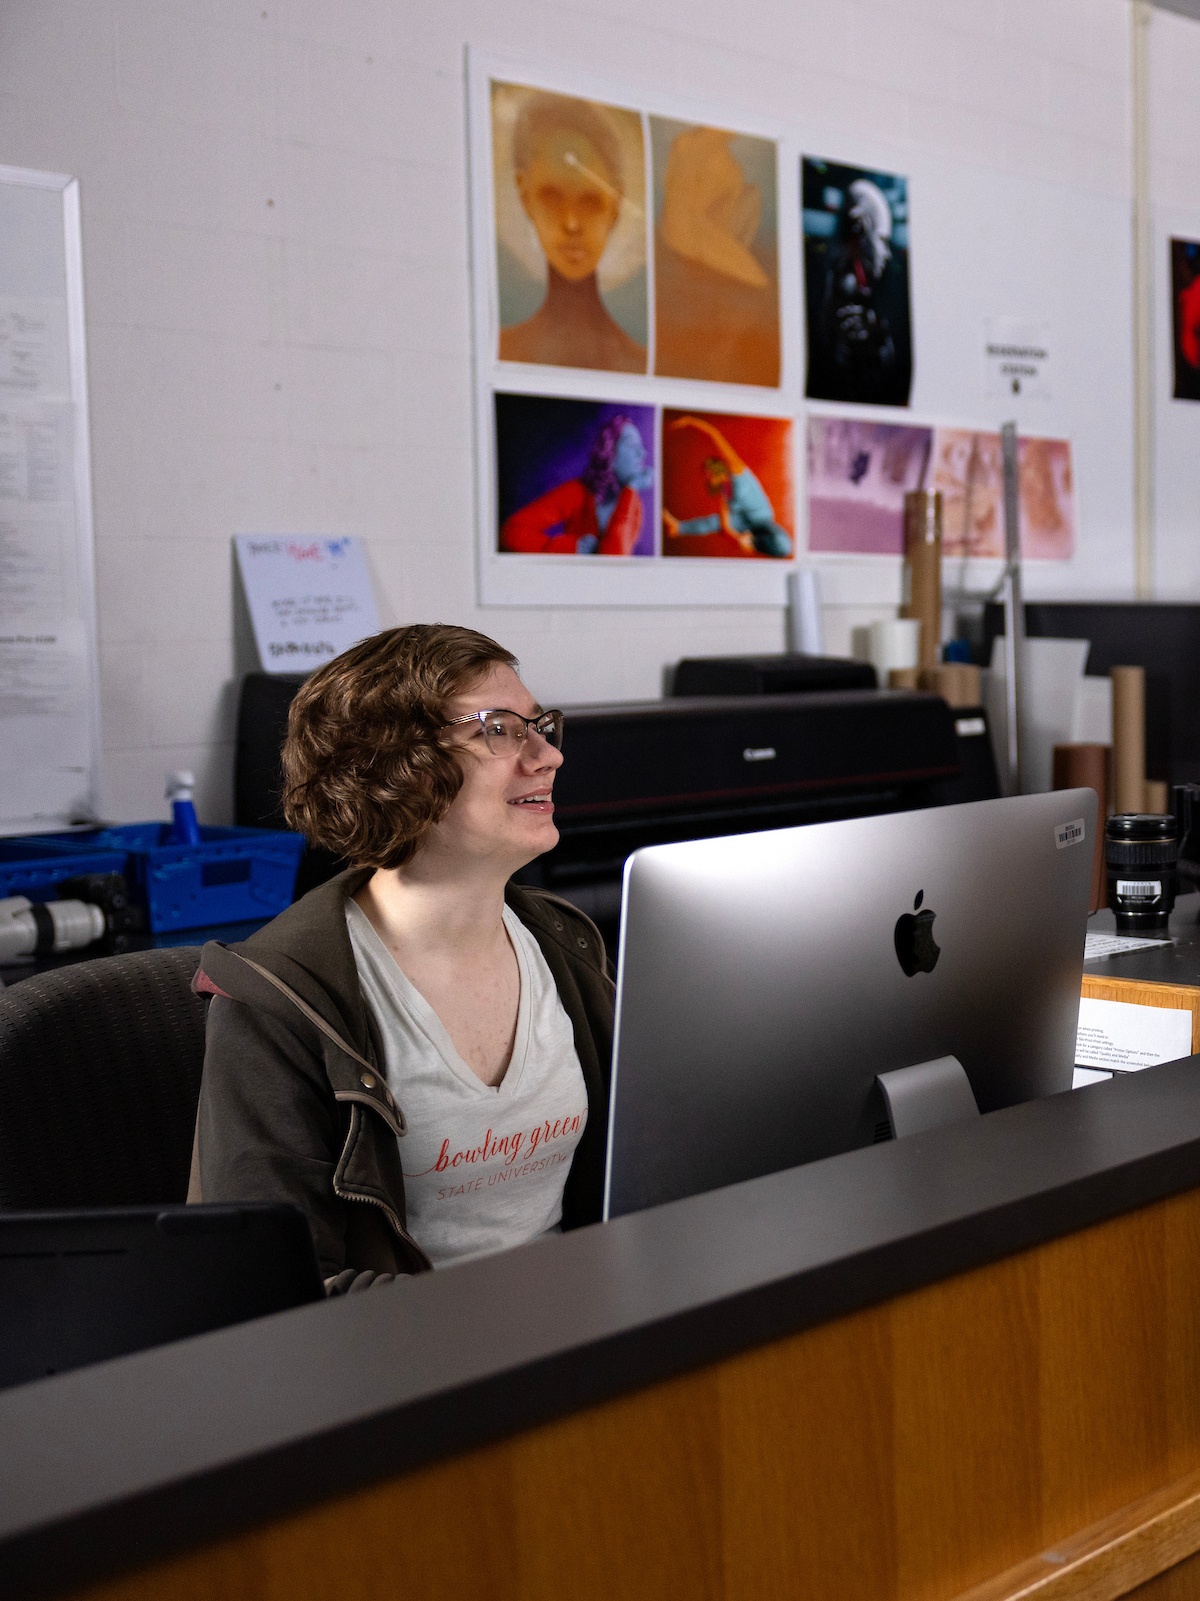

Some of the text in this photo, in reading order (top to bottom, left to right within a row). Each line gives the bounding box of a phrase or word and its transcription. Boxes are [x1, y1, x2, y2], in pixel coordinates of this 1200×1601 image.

[418, 1110, 584, 1173] bowling green
[437, 1153, 566, 1201] STATE UNIVERSITY
